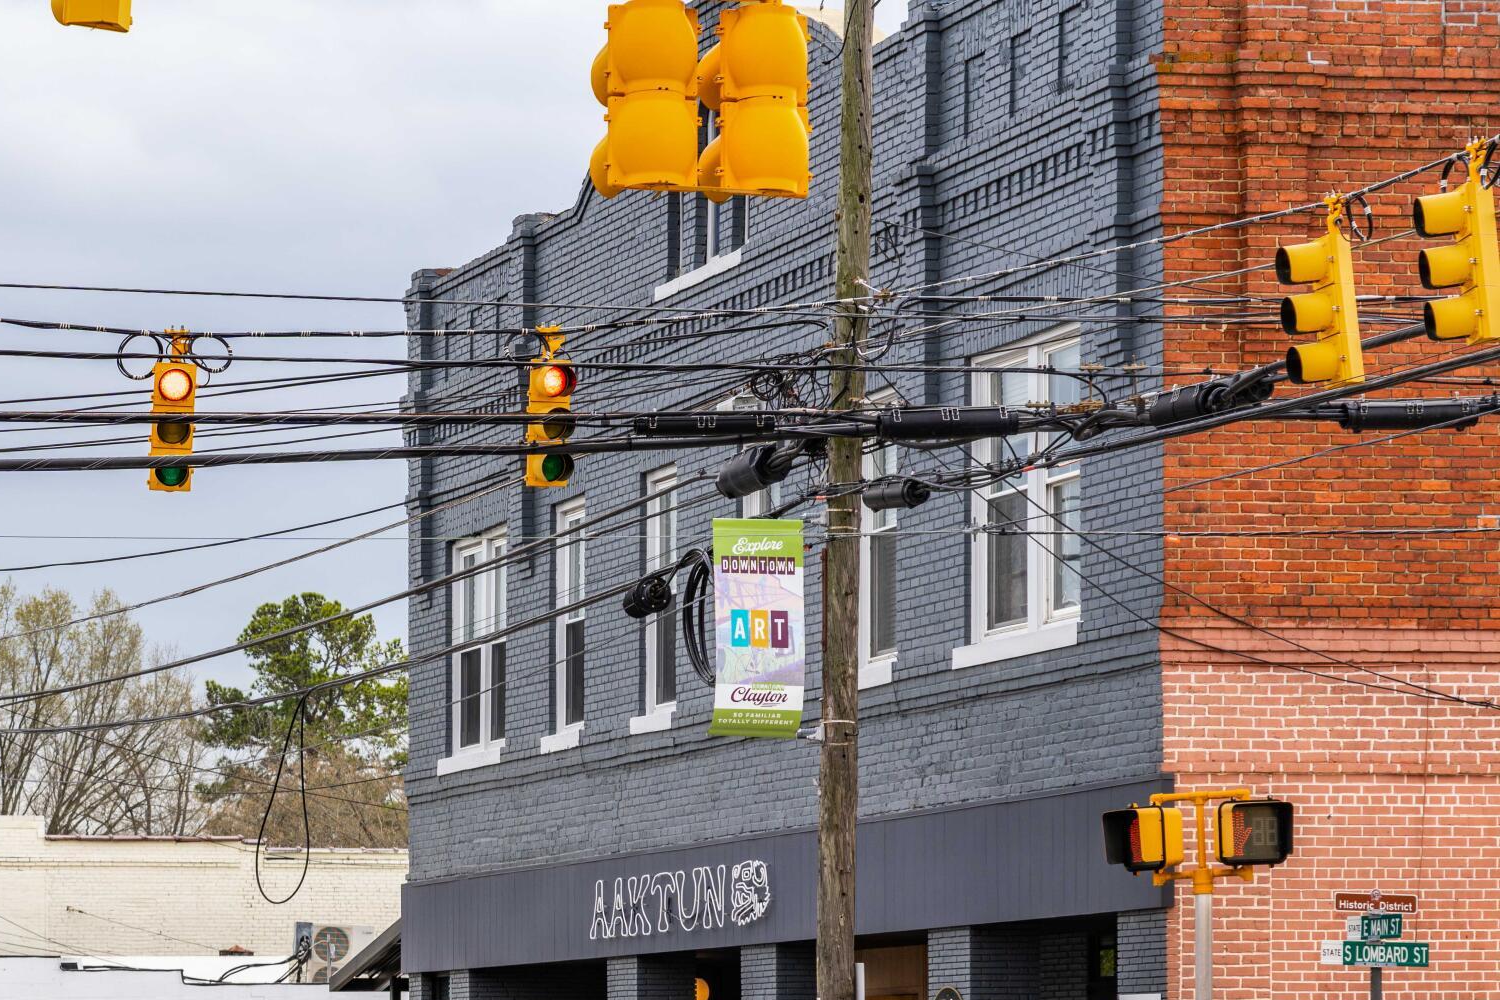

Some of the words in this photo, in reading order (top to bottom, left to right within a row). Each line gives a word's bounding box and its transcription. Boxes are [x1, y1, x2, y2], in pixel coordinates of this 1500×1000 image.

[731, 537, 784, 555] Explore
[722, 558, 795, 573] DOWNTOWN
[734, 617, 785, 641] ART
[731, 685, 789, 706] Clayton
[589, 864, 726, 940] AAKTUN
[1339, 899, 1375, 910] Historic
[1379, 901, 1413, 912] District
[1348, 924, 1361, 933] STATE
[1362, 919, 1369, 937] E
[1370, 918, 1389, 936] MAIN
[1390, 917, 1400, 935] ST
[1322, 948, 1341, 957] STATE
[1344, 945, 1352, 962] S
[1355, 945, 1409, 963] LOMBARD
[1413, 946, 1428, 963] ST
